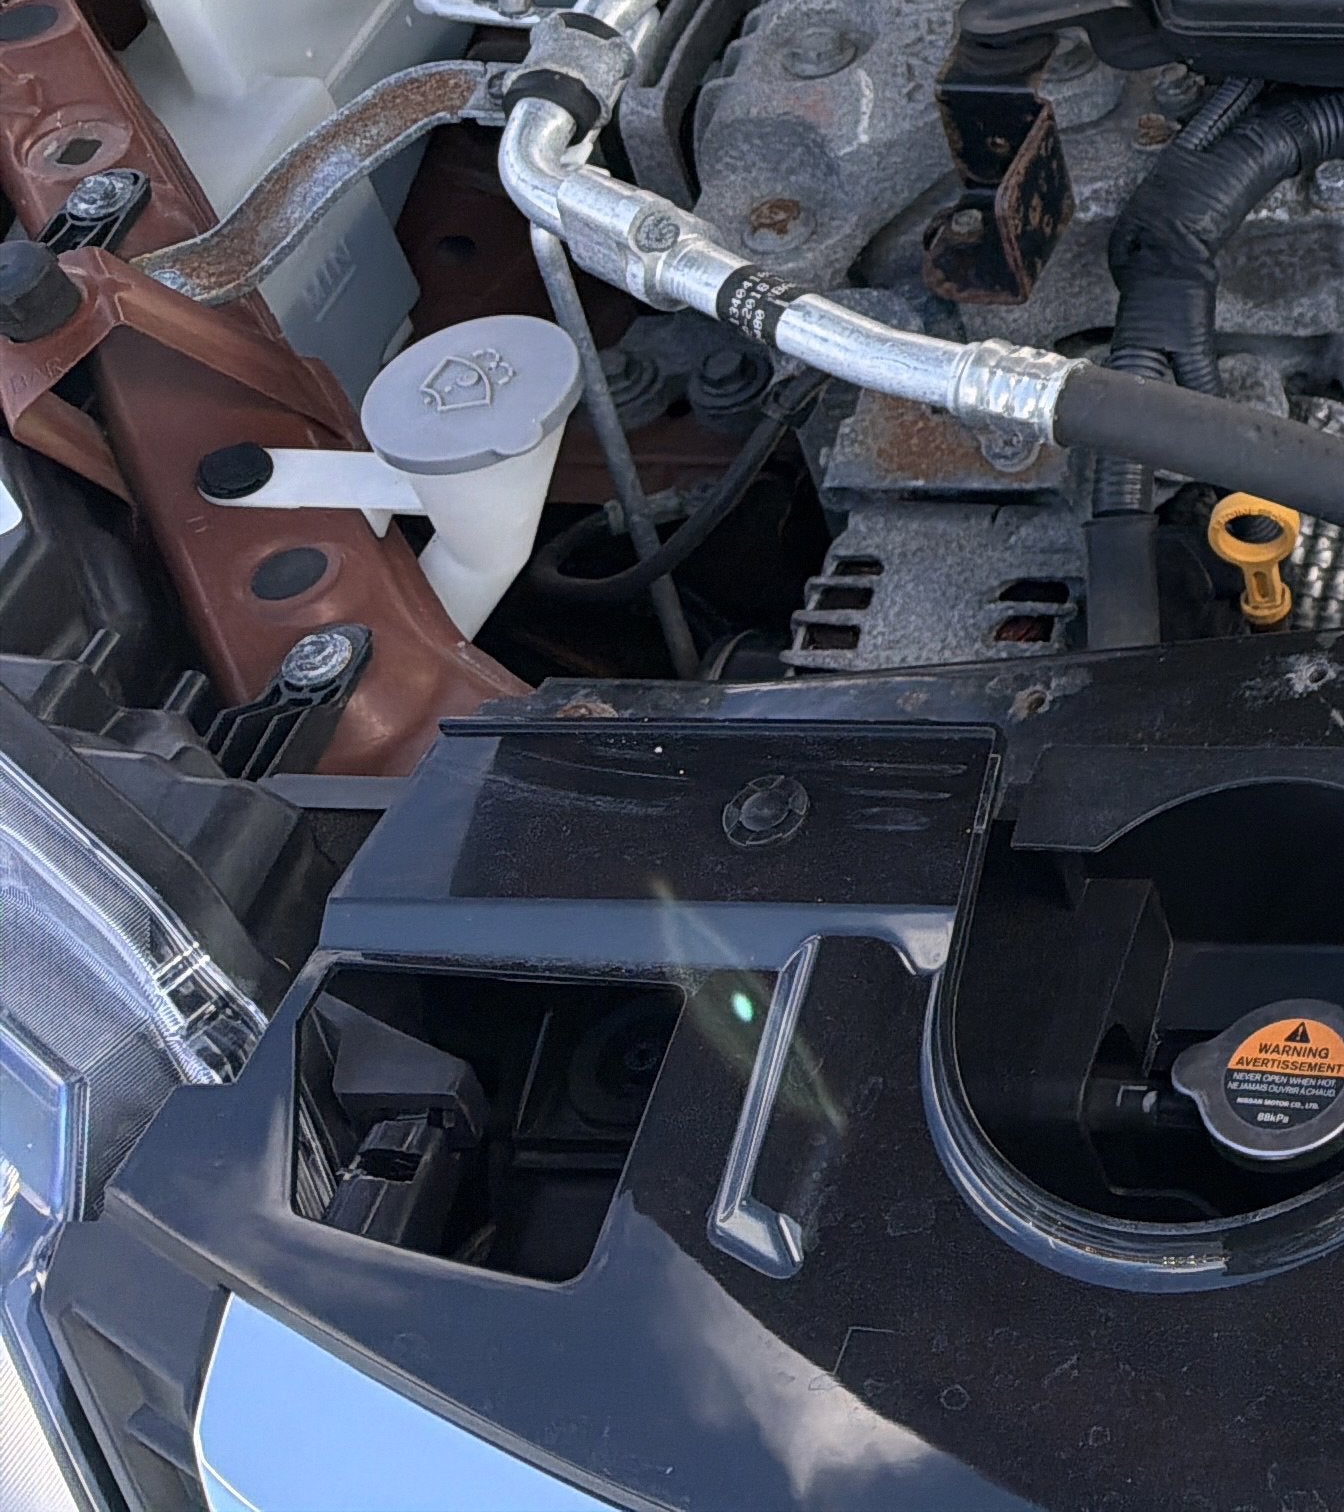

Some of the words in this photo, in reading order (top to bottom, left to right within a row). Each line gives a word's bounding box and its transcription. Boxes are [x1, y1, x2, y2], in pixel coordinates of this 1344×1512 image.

[1258, 1042, 1330, 1059] WARNING
[1235, 1055, 1344, 1074] AVERTISSEMENT
[1233, 1072, 1262, 1081] NEVER
[1263, 1074, 1288, 1084] OPEN
[1289, 1076, 1315, 1086] WHEN
[1228, 1081, 1239, 1090] NE
[1240, 1083, 1268, 1092] JAMAIS
[1269, 1085, 1299, 1095] OUVRIR
[1236, 1097, 1263, 1105] NISSAN
[1263, 1099, 1290, 1107] MOTOR
